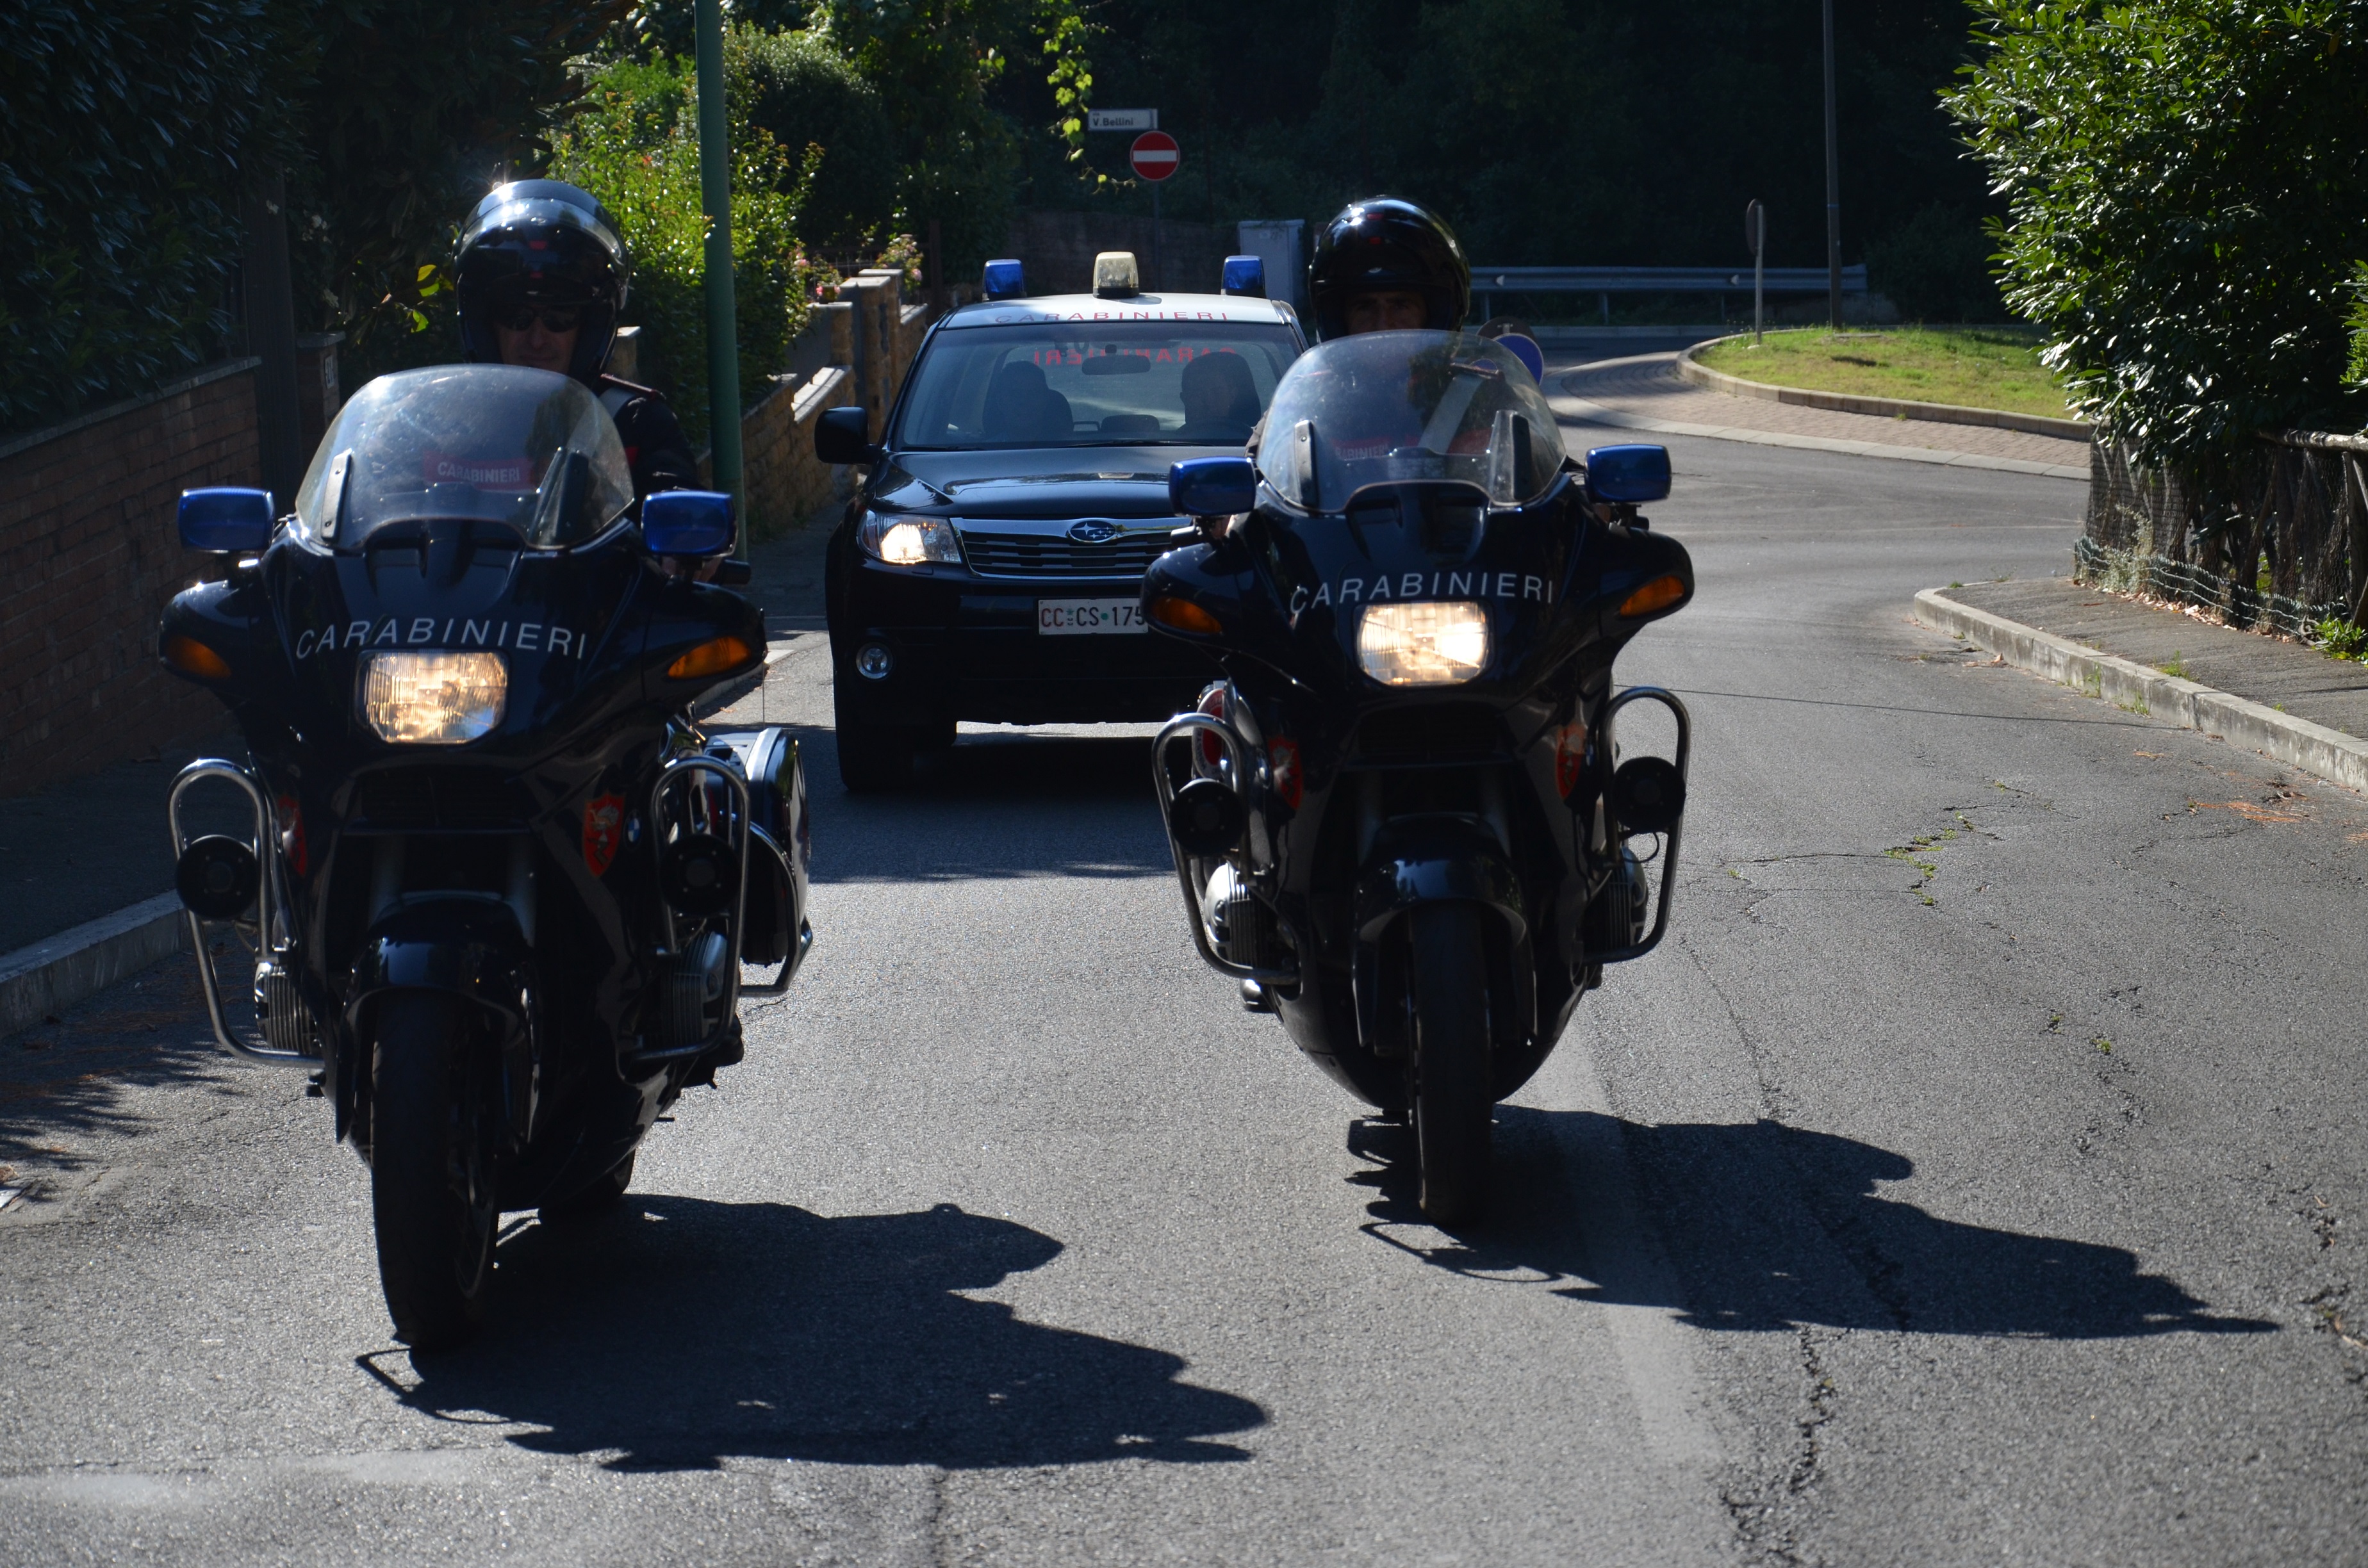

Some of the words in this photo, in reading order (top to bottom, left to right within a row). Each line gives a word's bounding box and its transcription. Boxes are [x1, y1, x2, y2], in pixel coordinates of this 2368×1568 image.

[995, 311, 1228, 323] CARABINIERI
[437, 461, 521, 483] CARABINIERI
[1289, 571, 1553, 616] CARABINIERI
[1041, 607, 1064, 627] CC
[1076, 607, 1099, 626] CS
[1112, 606, 1146, 626] 175
[296, 617, 586, 660] CARABINIERI
